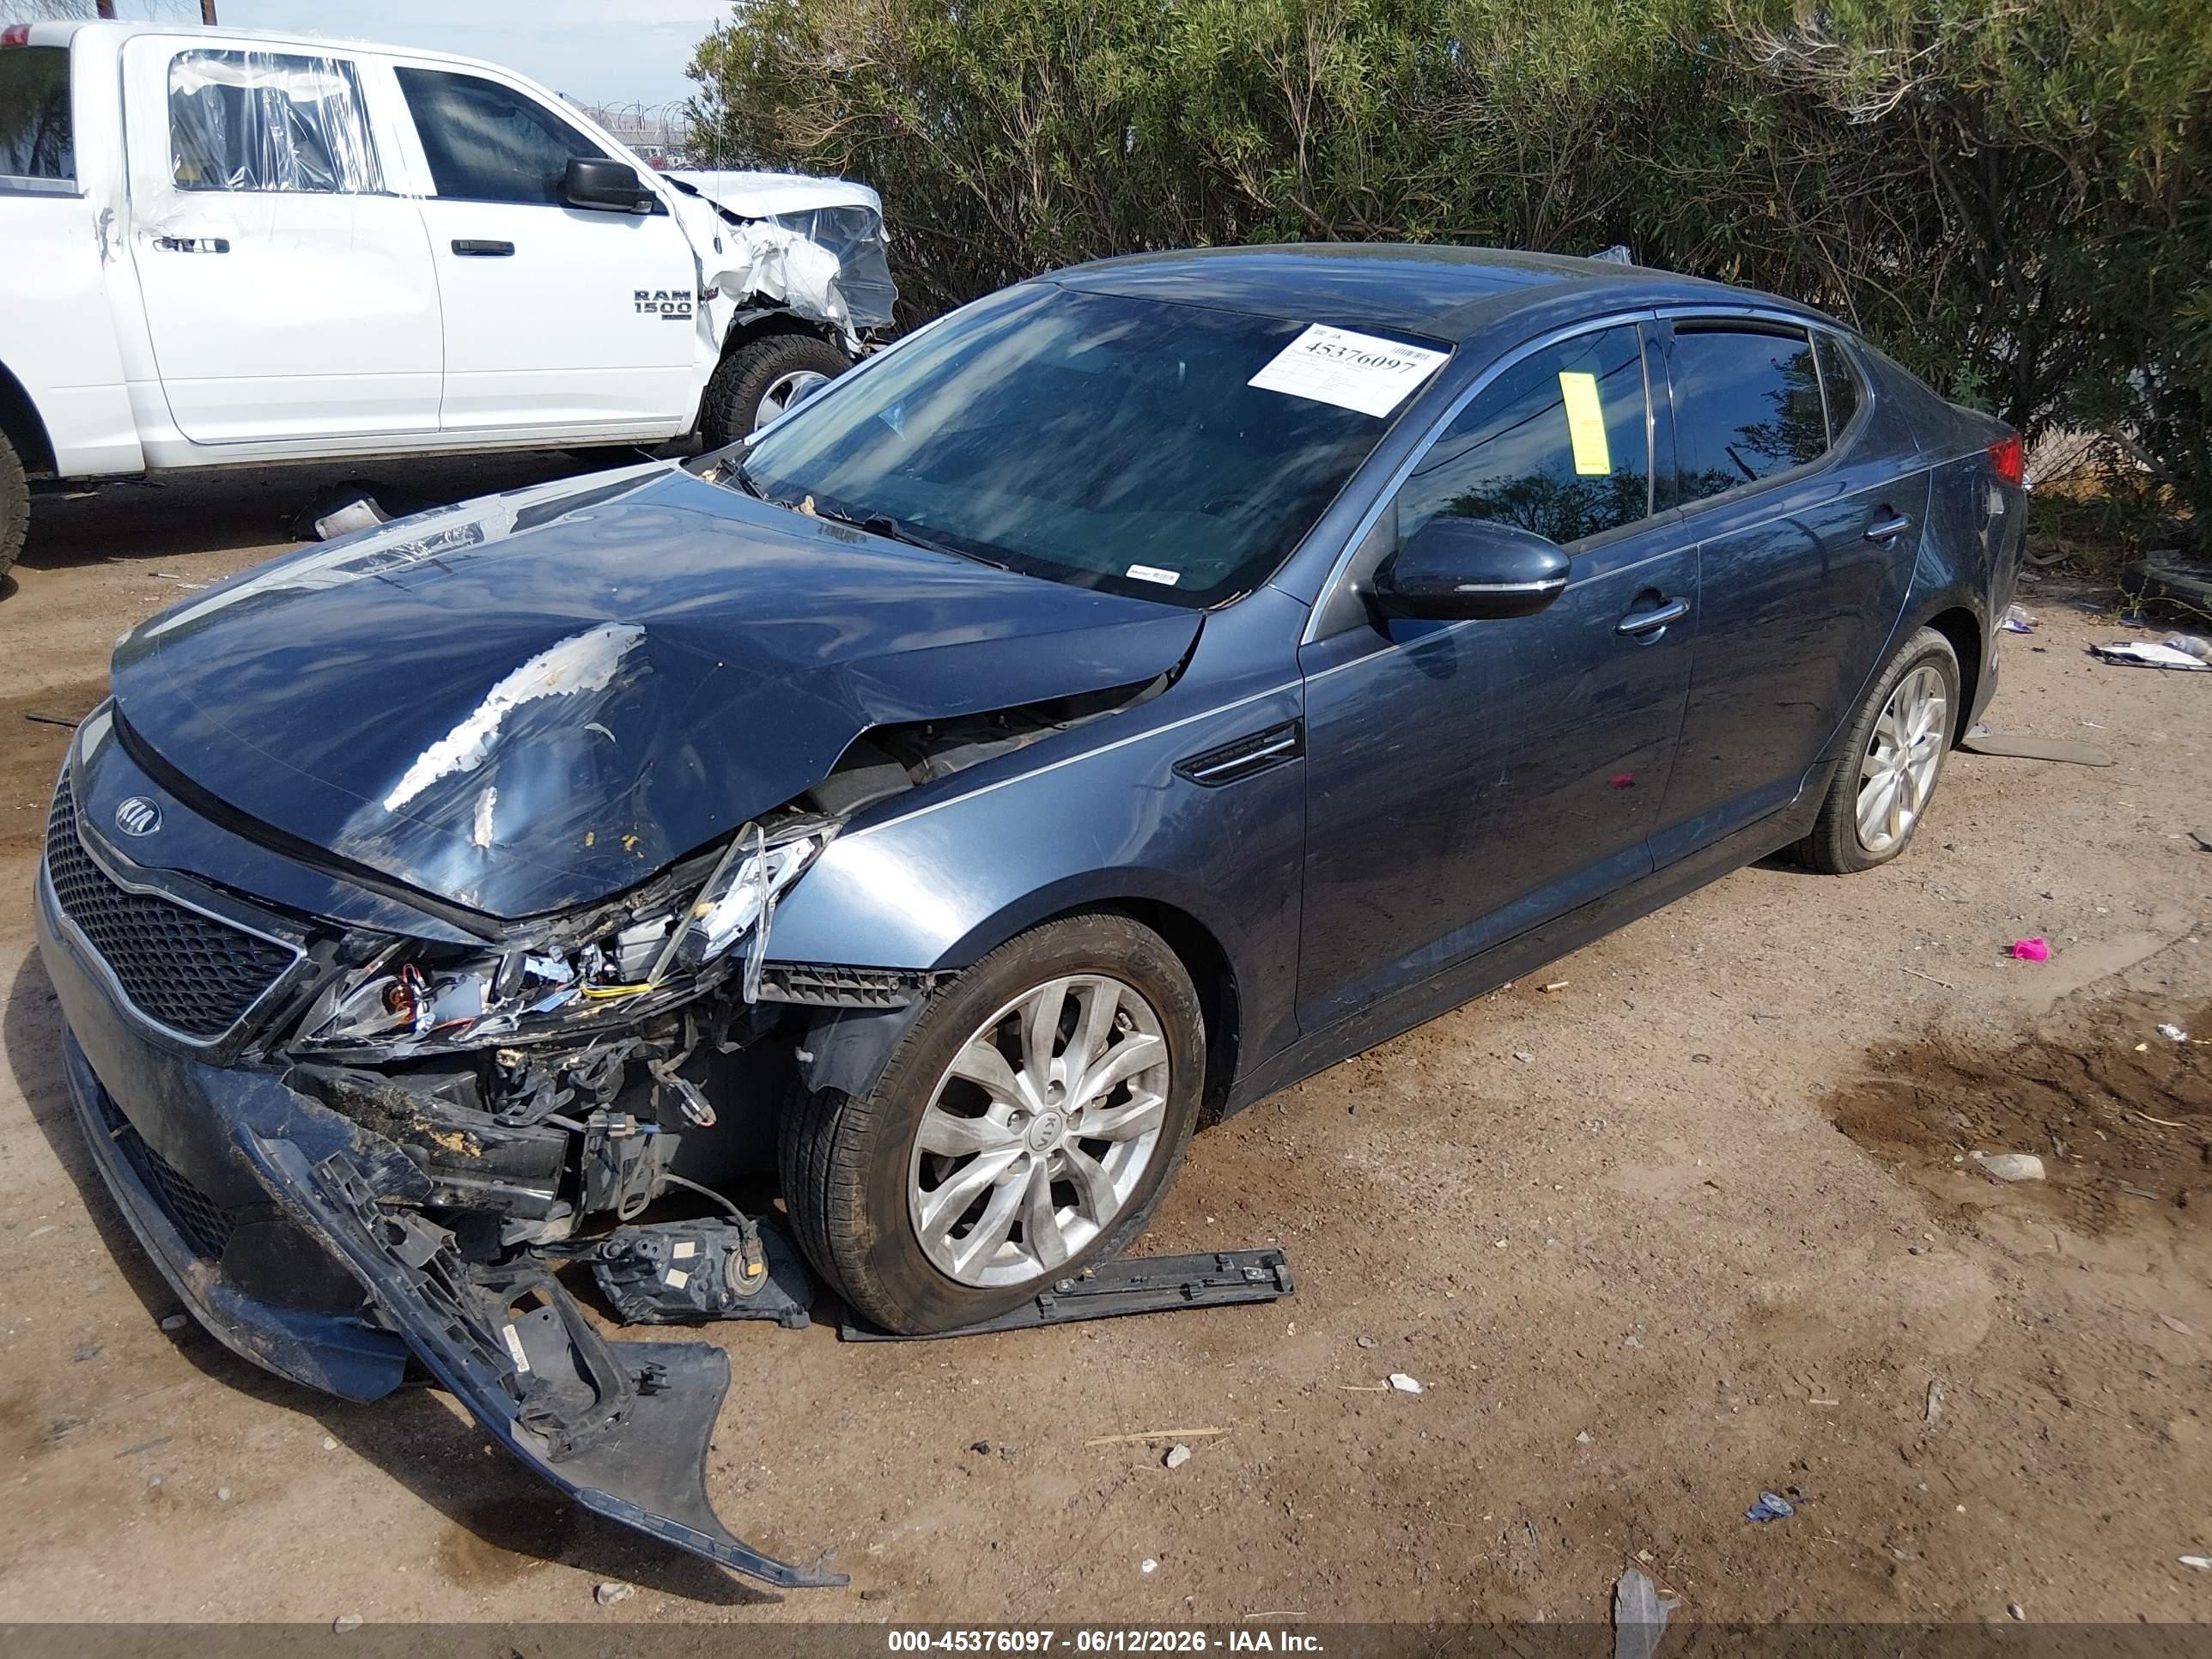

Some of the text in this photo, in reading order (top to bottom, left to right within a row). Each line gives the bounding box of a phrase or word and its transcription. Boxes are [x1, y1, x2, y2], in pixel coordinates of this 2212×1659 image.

[634, 290, 691, 301] RAM
[635, 302, 692, 313] 1500
[1304, 341, 1418, 374] 45376097
[118, 798, 155, 832] KIA
[1036, 1117, 1056, 1148] KIA
